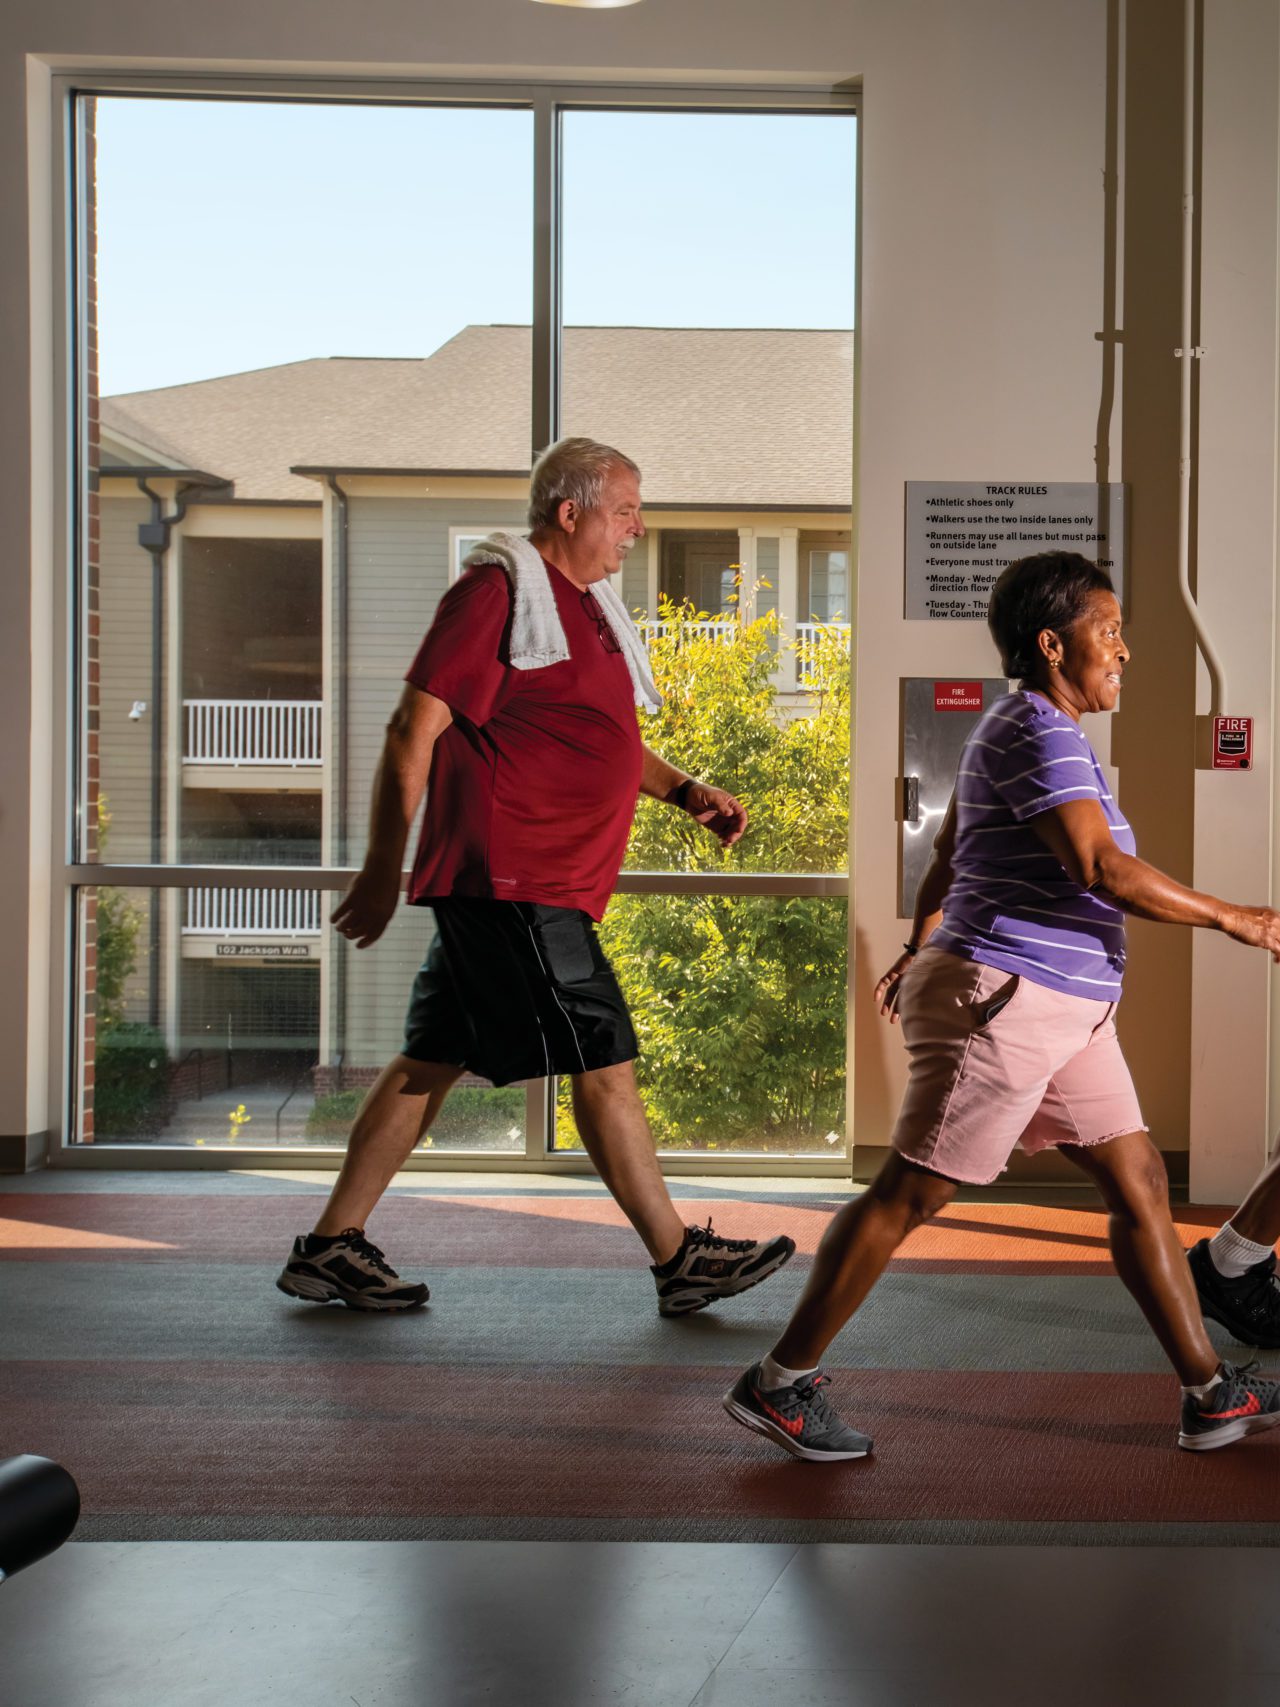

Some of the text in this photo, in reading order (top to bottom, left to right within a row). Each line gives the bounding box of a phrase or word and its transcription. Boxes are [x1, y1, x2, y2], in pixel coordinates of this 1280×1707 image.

[986, 486, 1047, 495] TRACK RULES
[930, 498, 964, 506] Athletic
[995, 499, 1014, 508] only
[930, 515, 965, 523] Walkers
[985, 515, 999, 523] the
[1020, 515, 1046, 524] inside
[1048, 516, 1072, 524] lanes
[1075, 516, 1093, 525] only
[930, 532, 966, 540] Runners
[968, 533, 986, 542] may
[1007, 532, 1017, 540] all
[1020, 532, 1042, 540] lanes
[1045, 532, 1059, 540] but
[1062, 533, 1083, 541] must
[1086, 534, 1106, 542] pass
[943, 541, 976, 549] outside
[931, 558, 971, 567] Everyone
[930, 575, 965, 584] Monday
[930, 584, 968, 592] direction
[971, 584, 989, 592] flow
[930, 600, 966, 610] Tuesday
[930, 610, 948, 618] flow
[1218, 719, 1248, 730] FIRE
[218, 946, 307, 954] 102 Jackson Walk
